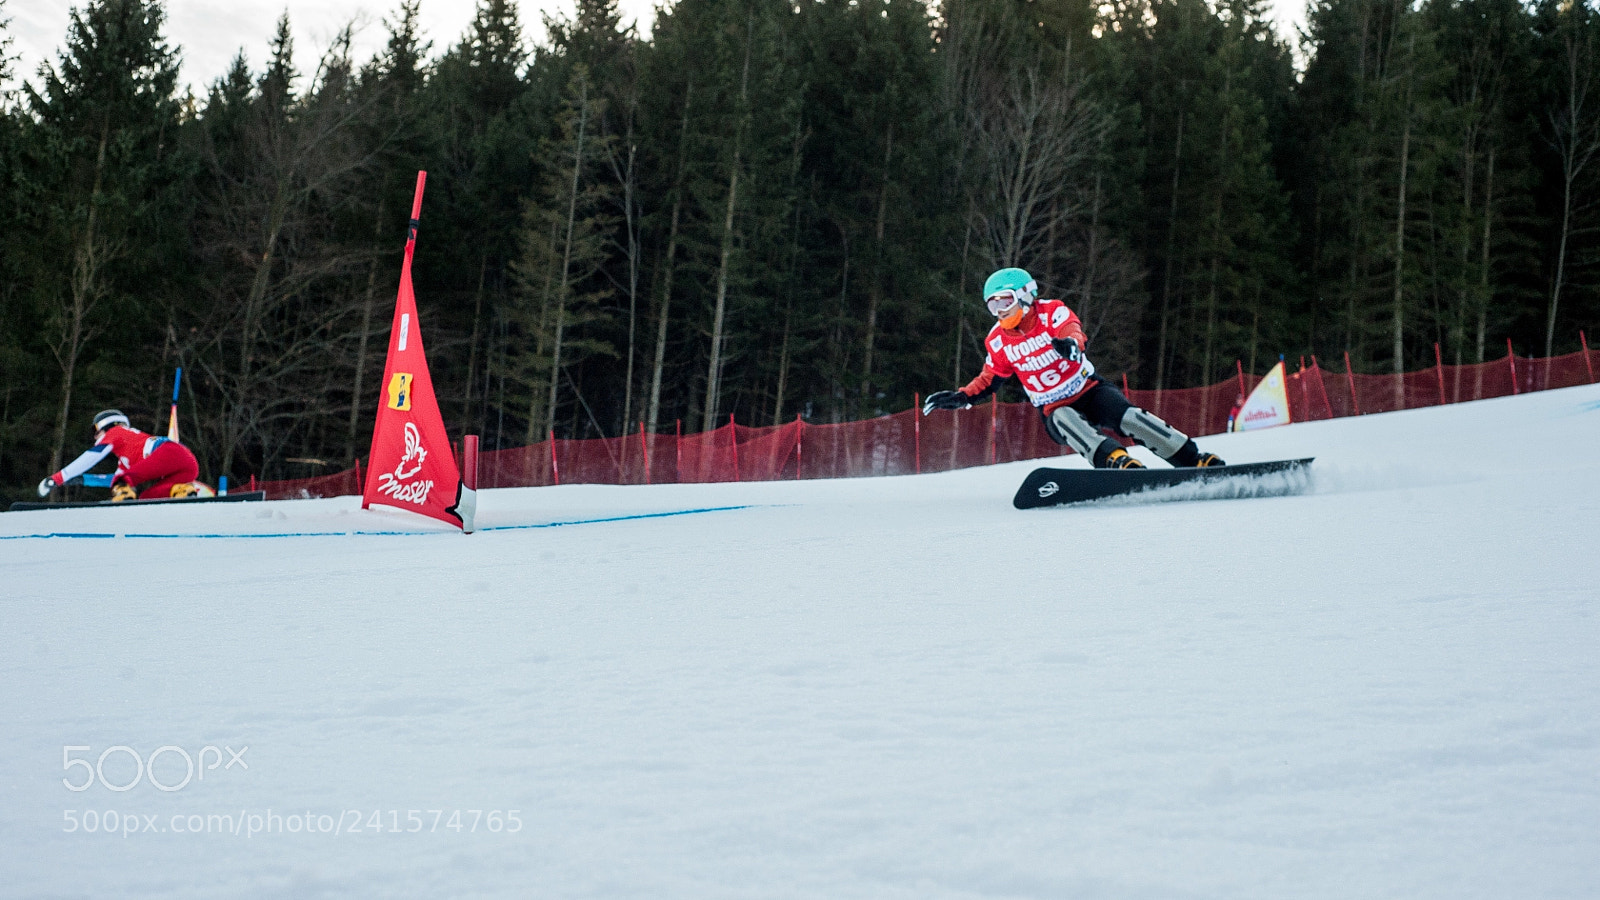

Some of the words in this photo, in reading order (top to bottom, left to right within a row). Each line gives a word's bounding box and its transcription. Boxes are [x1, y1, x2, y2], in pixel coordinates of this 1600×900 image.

[1003, 331, 1052, 363] Kronen
[1013, 348, 1063, 372] eitun
[1026, 369, 1061, 392] 16
